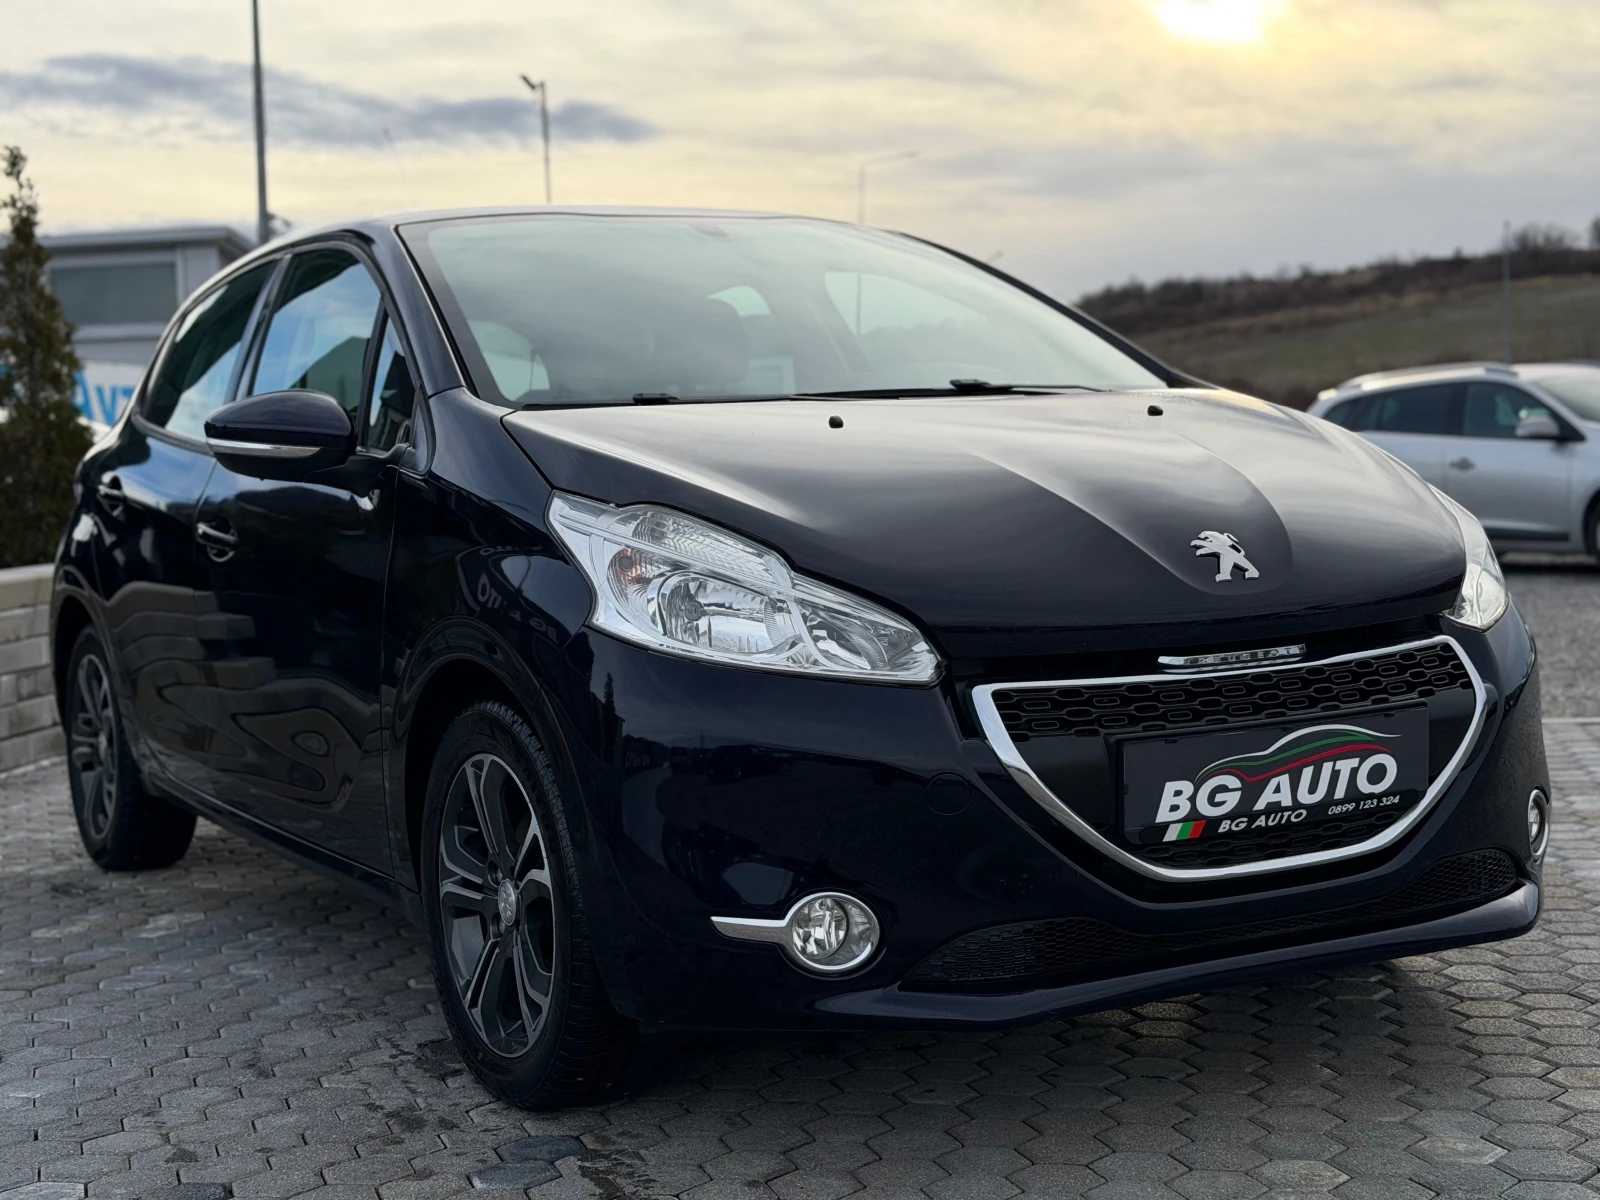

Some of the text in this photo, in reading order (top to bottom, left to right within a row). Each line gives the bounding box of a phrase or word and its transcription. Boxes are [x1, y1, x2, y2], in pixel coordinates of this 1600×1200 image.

[1155, 753, 1398, 824] BG AUTO
[1328, 795, 1400, 815] 0899 123 324
[1217, 809, 1308, 833] BG AUTO
